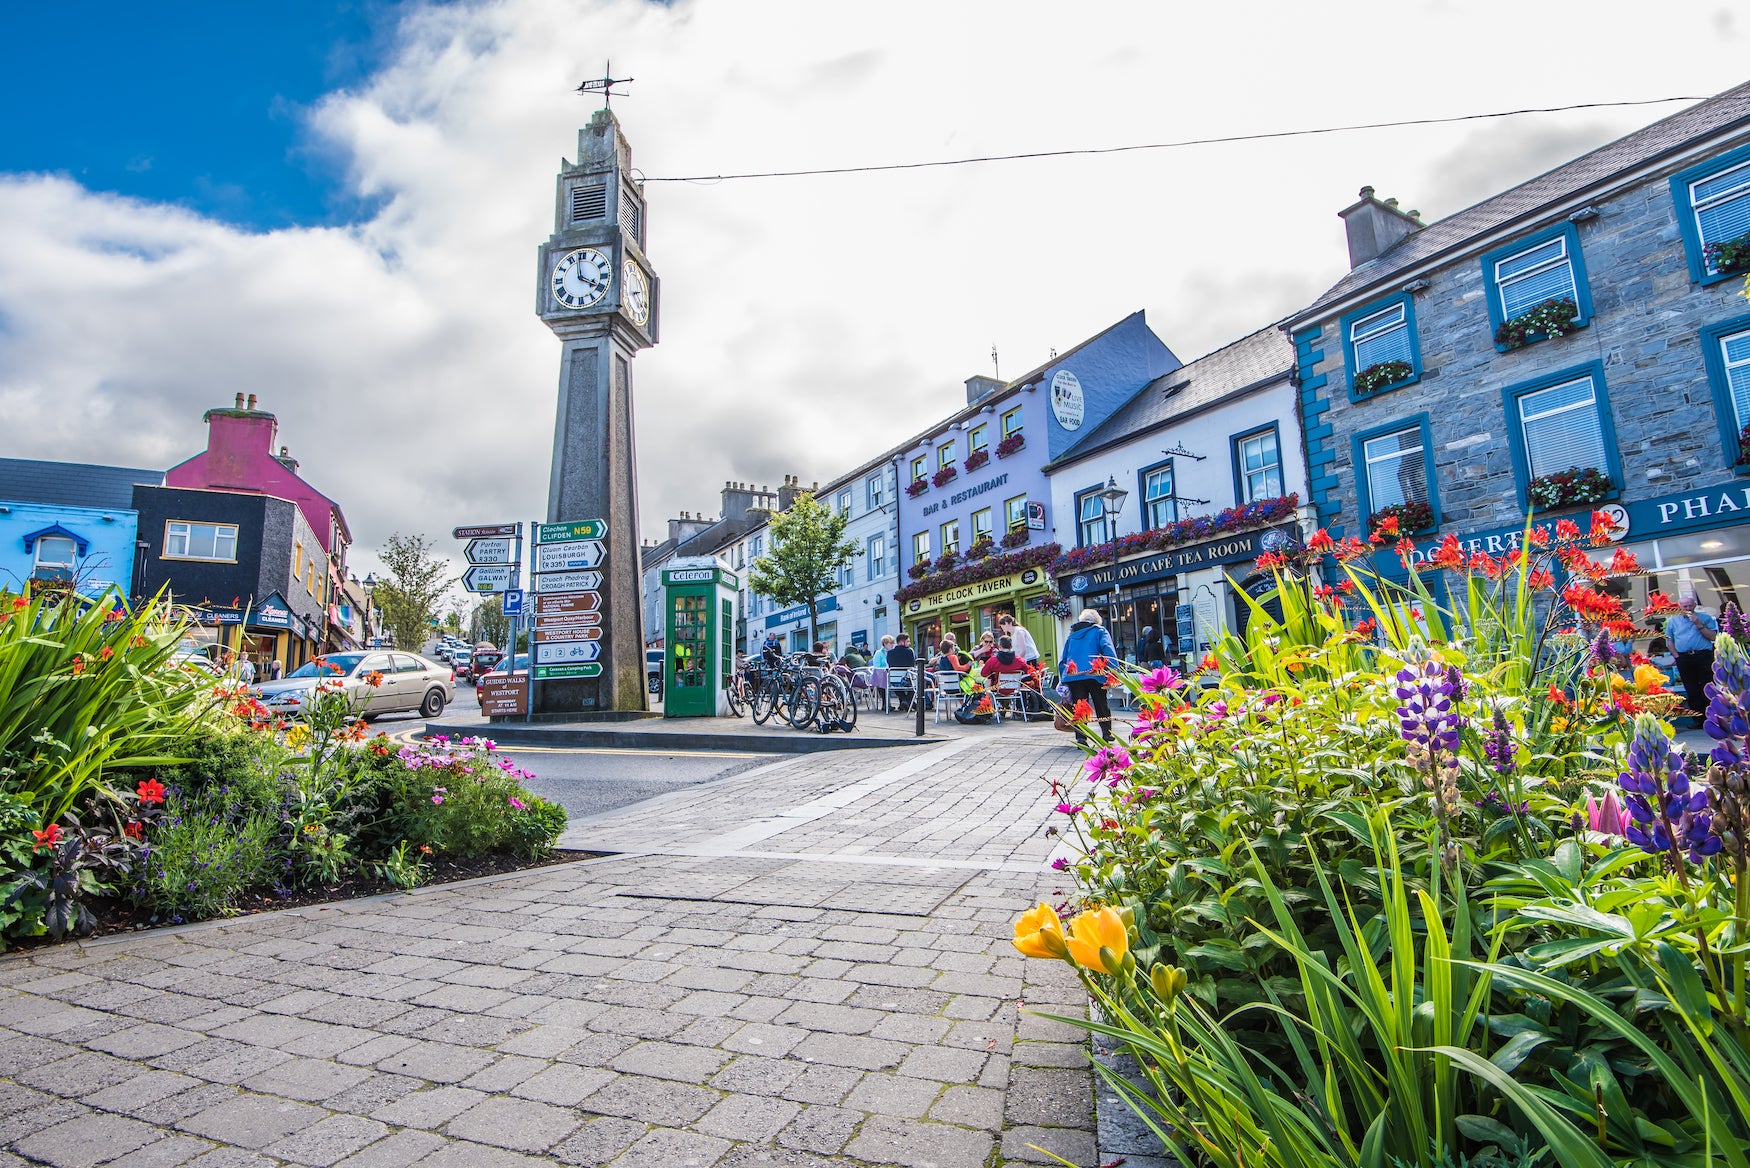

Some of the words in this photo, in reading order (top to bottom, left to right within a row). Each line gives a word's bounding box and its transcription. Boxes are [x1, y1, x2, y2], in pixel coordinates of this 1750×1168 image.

[1064, 401, 1082, 411] MUSIC
[1069, 418, 1080, 426] FOOD
[923, 502, 939, 516] BAR
[942, 501, 948, 509] &
[951, 473, 1008, 505] RESTAURANT
[574, 526, 591, 535] N59
[543, 552, 585, 560] LOUISBURGH
[1093, 563, 1139, 584] WILOW
[1142, 554, 1174, 574] CAFÉ
[1177, 551, 1203, 566] TEA
[1208, 540, 1252, 560] ROOM
[929, 595, 943, 606] THE
[946, 587, 974, 602] CLOCK
[977, 578, 1012, 594] TAVERN
[507, 592, 520, 608] P
[780, 613, 790, 622] Bank
[794, 608, 806, 618] Ireland
